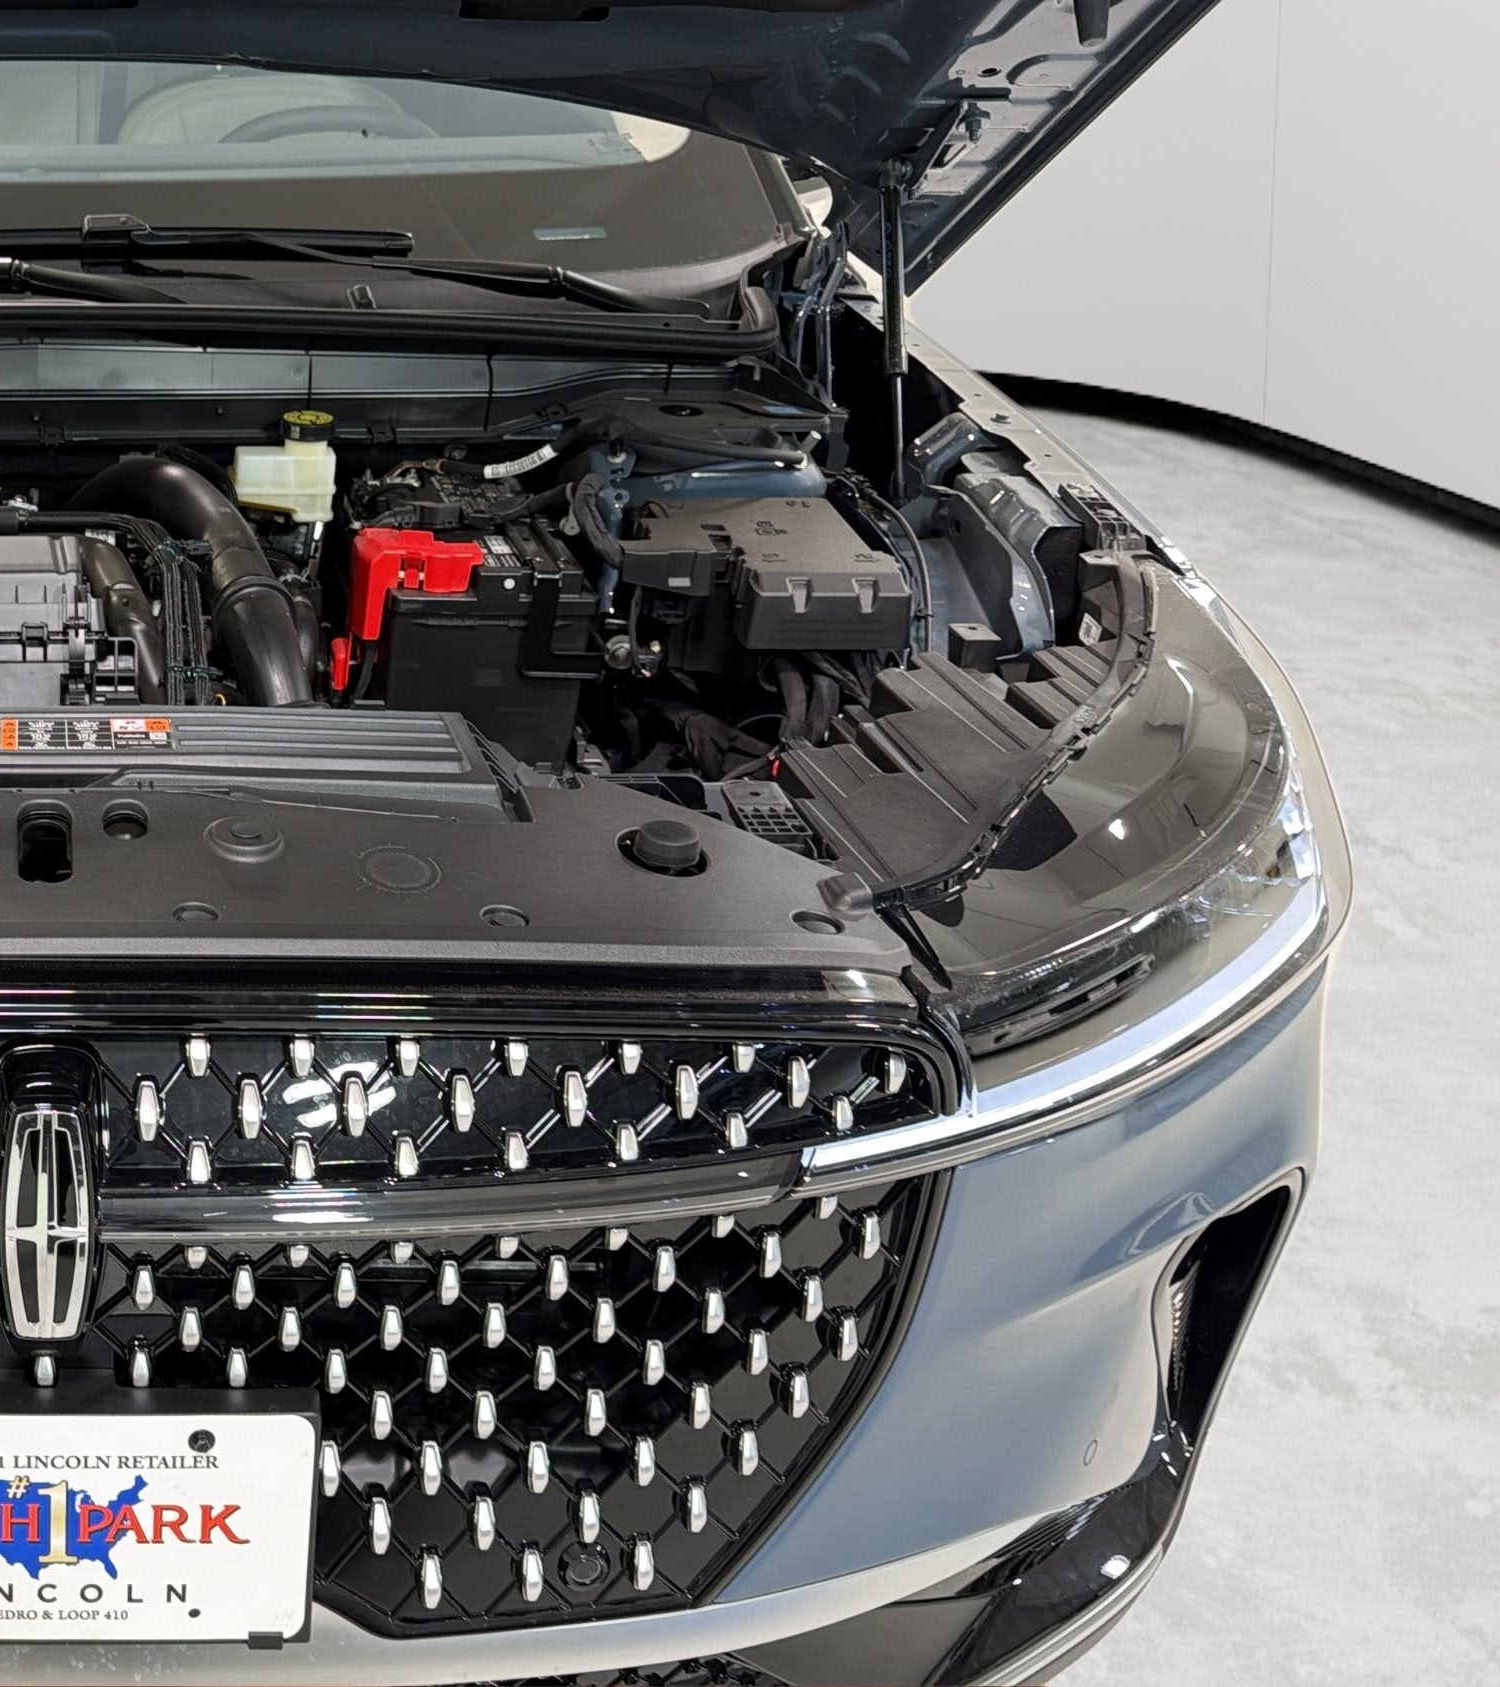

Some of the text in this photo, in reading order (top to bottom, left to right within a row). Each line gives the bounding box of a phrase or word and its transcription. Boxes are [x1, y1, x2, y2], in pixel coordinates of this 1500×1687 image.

[13, 1455, 111, 1469] LINCOLN
[117, 1455, 219, 1469] RETAILER
[76, 1503, 251, 1544] PARK
[42, 1609, 54, 1620] &
[58, 1609, 100, 1620] LOOP
[104, 1609, 129, 1620] 410
